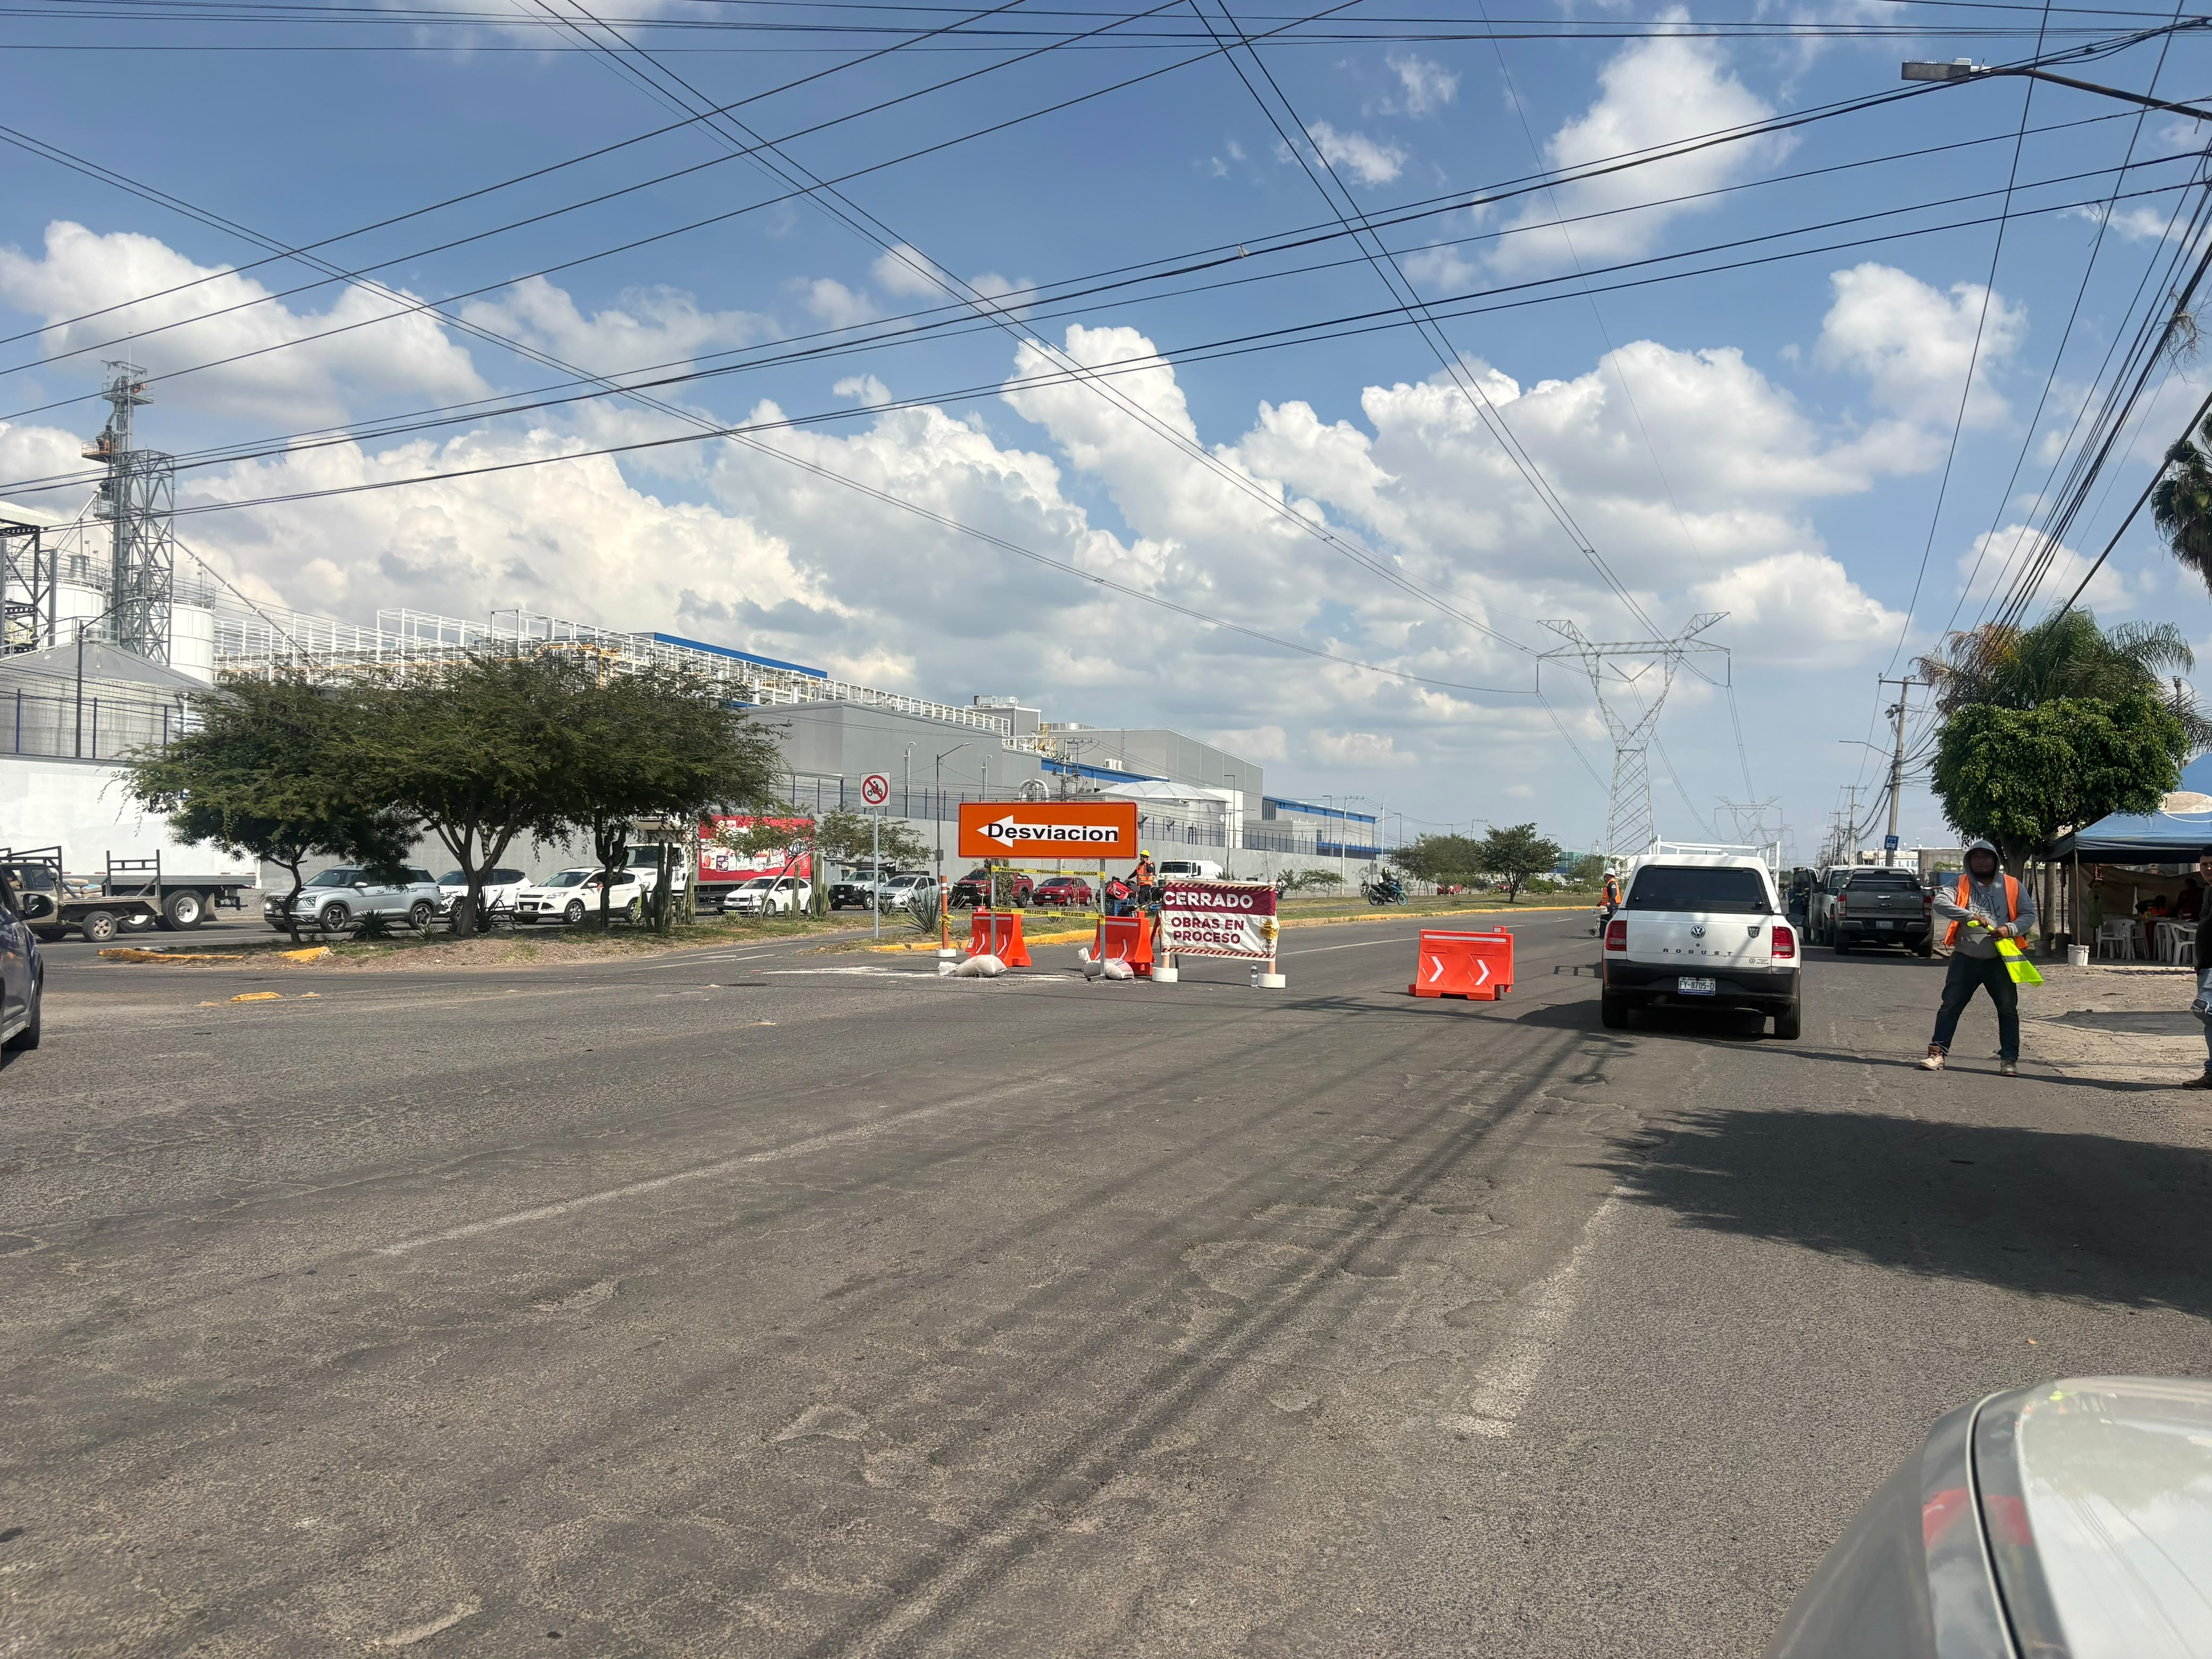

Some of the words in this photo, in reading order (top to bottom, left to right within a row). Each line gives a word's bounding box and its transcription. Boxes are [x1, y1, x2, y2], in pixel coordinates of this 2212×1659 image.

[988, 823, 1118, 841] Desviacion
[1163, 891, 1253, 909] CERRADO
[1171, 917, 1220, 929] OBRAS
[1225, 919, 1244, 931] EN
[1174, 931, 1241, 944] PROCESO
[1680, 981, 1714, 990] FY-8705-D
